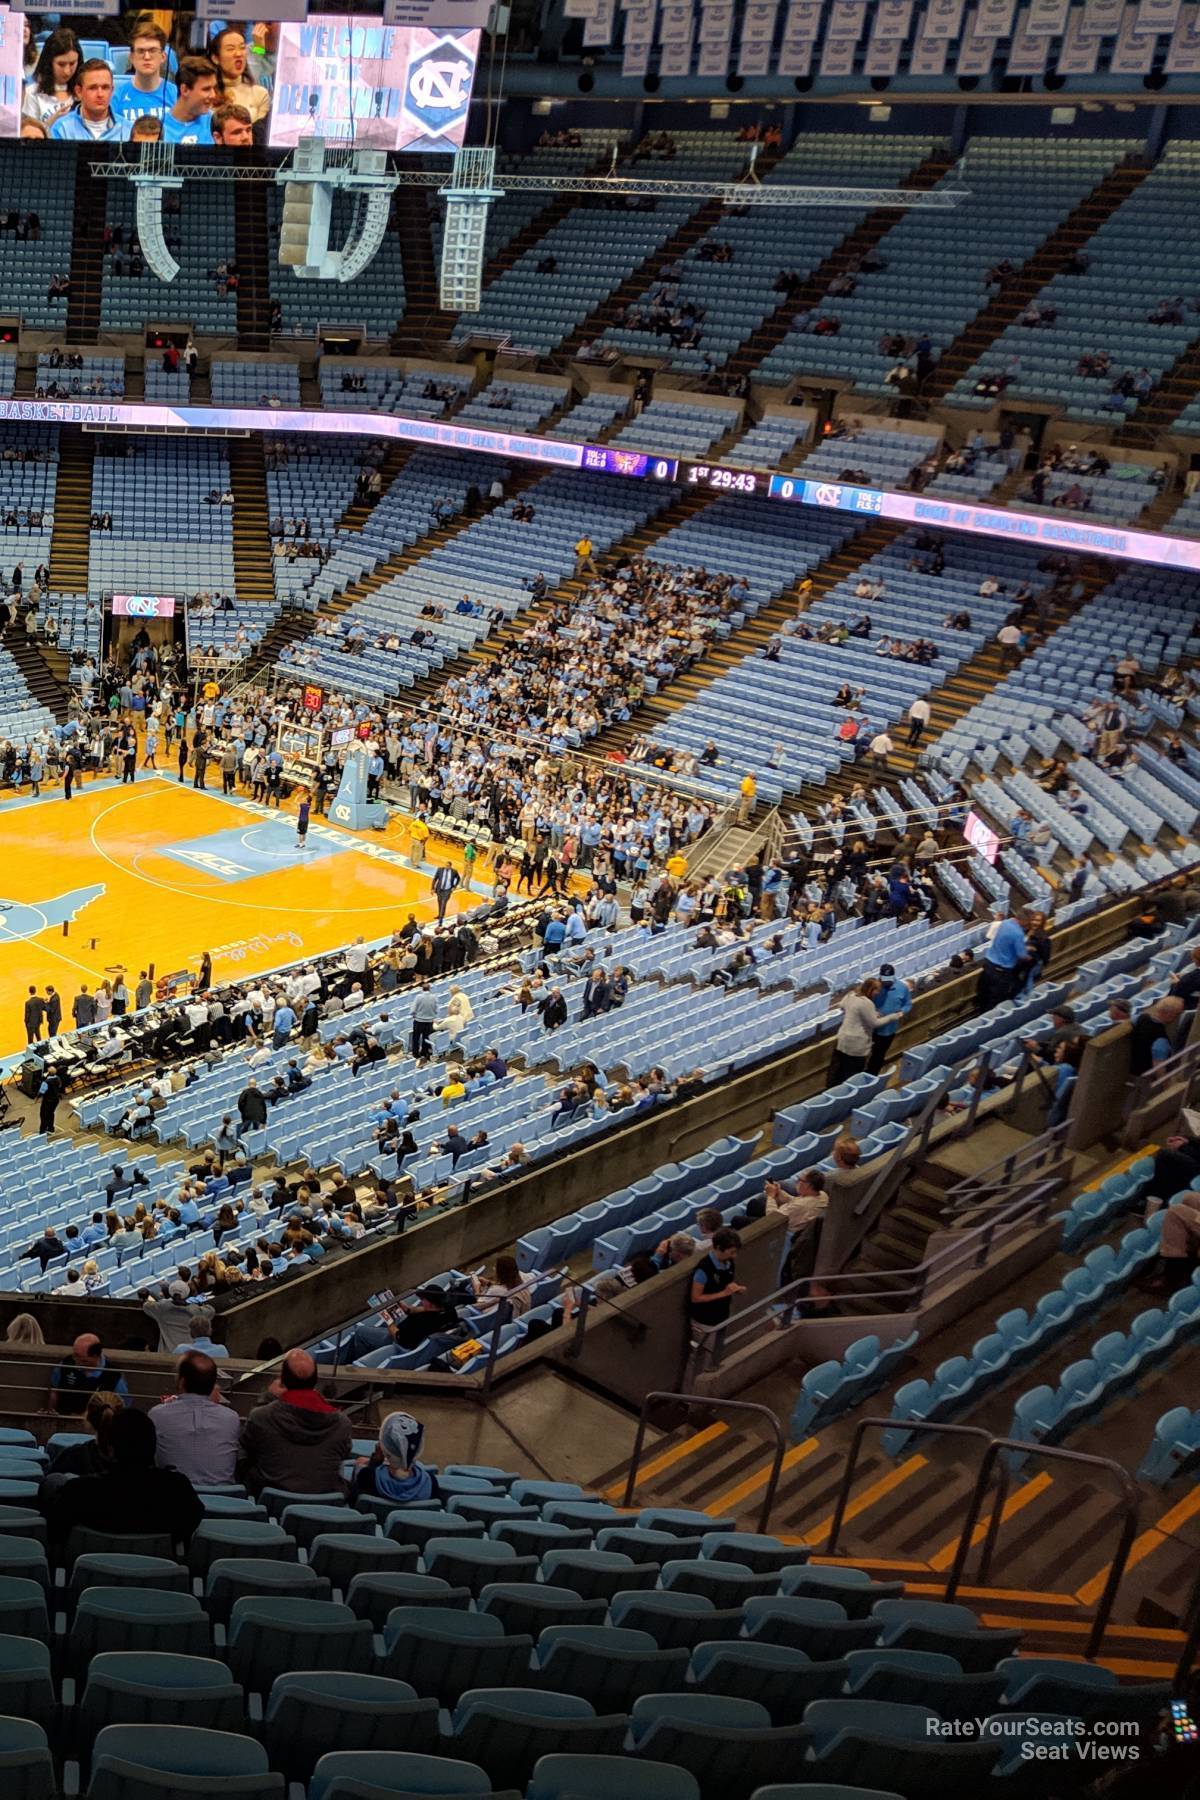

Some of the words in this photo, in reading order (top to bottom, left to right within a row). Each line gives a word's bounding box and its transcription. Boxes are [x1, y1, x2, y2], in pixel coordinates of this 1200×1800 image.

[301, 25, 396, 60] WELCOME
[656, 461, 668, 478] 0
[711, 469, 757, 492] 29:43
[781, 481, 794, 498] 0
[1041, 523, 1128, 552] BASKETBALL
[239, 801, 412, 867] CAROLINA
[165, 849, 256, 876] ACC
